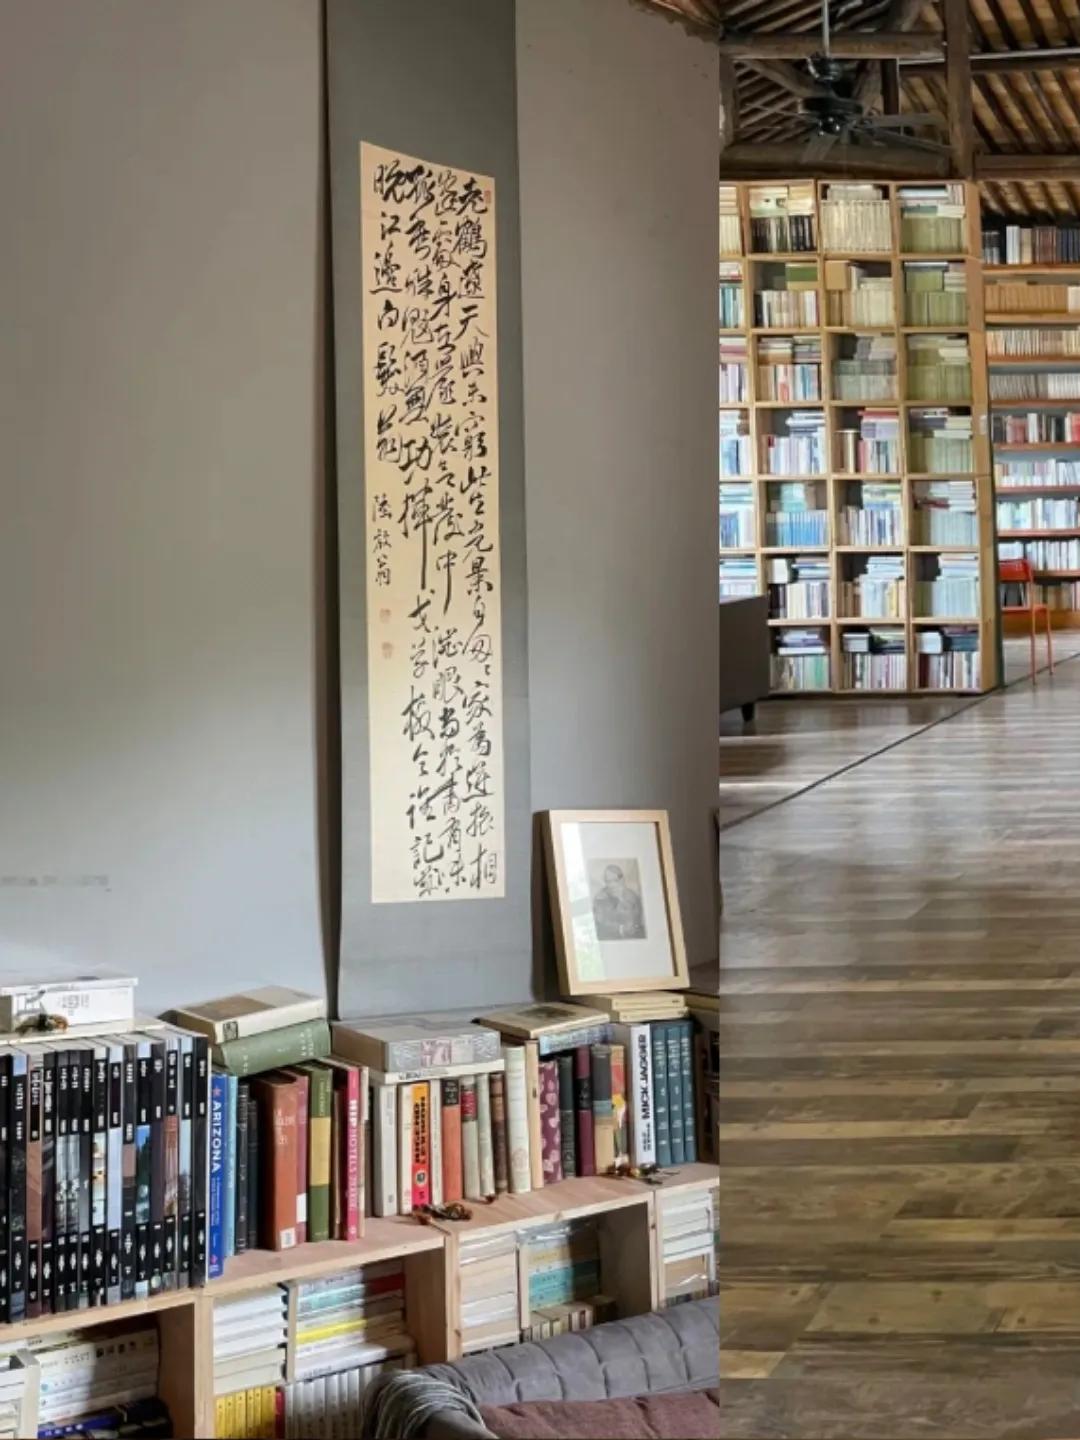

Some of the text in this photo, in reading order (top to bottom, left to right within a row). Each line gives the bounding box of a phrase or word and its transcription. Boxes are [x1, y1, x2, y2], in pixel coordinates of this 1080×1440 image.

[638, 1034, 650, 1084] JAGGER
[640, 1085, 651, 1120] MICK
[211, 1101, 222, 1173] ARIZONA
